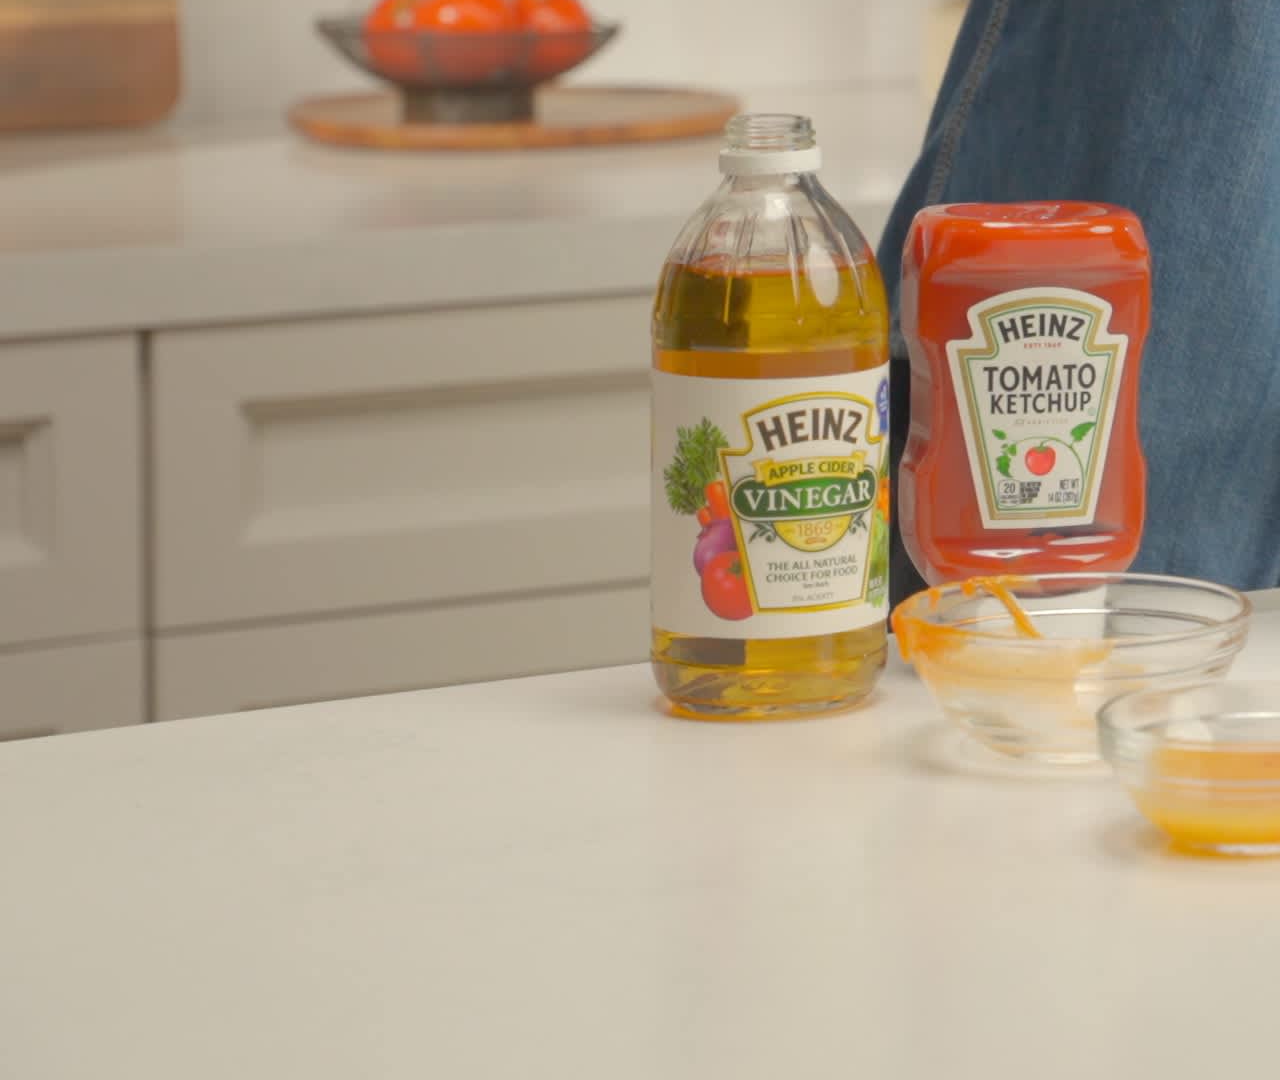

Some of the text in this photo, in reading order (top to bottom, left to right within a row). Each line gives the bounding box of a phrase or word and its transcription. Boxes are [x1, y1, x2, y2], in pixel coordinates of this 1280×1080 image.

[998, 313, 1086, 344] HEINZ
[983, 363, 1097, 393] TOMATO
[990, 392, 1092, 415] KETCHUP
[756, 407, 863, 453] HEINZ
[768, 461, 856, 481] APPLE CIDER
[743, 479, 872, 512] VINEGAR
[1003, 482, 1016, 494] 20
[797, 520, 833, 537] 1869
[768, 554, 857, 571] THE ALL NATURAL
[766, 565, 858, 583] CHOICE FOR FOOD
